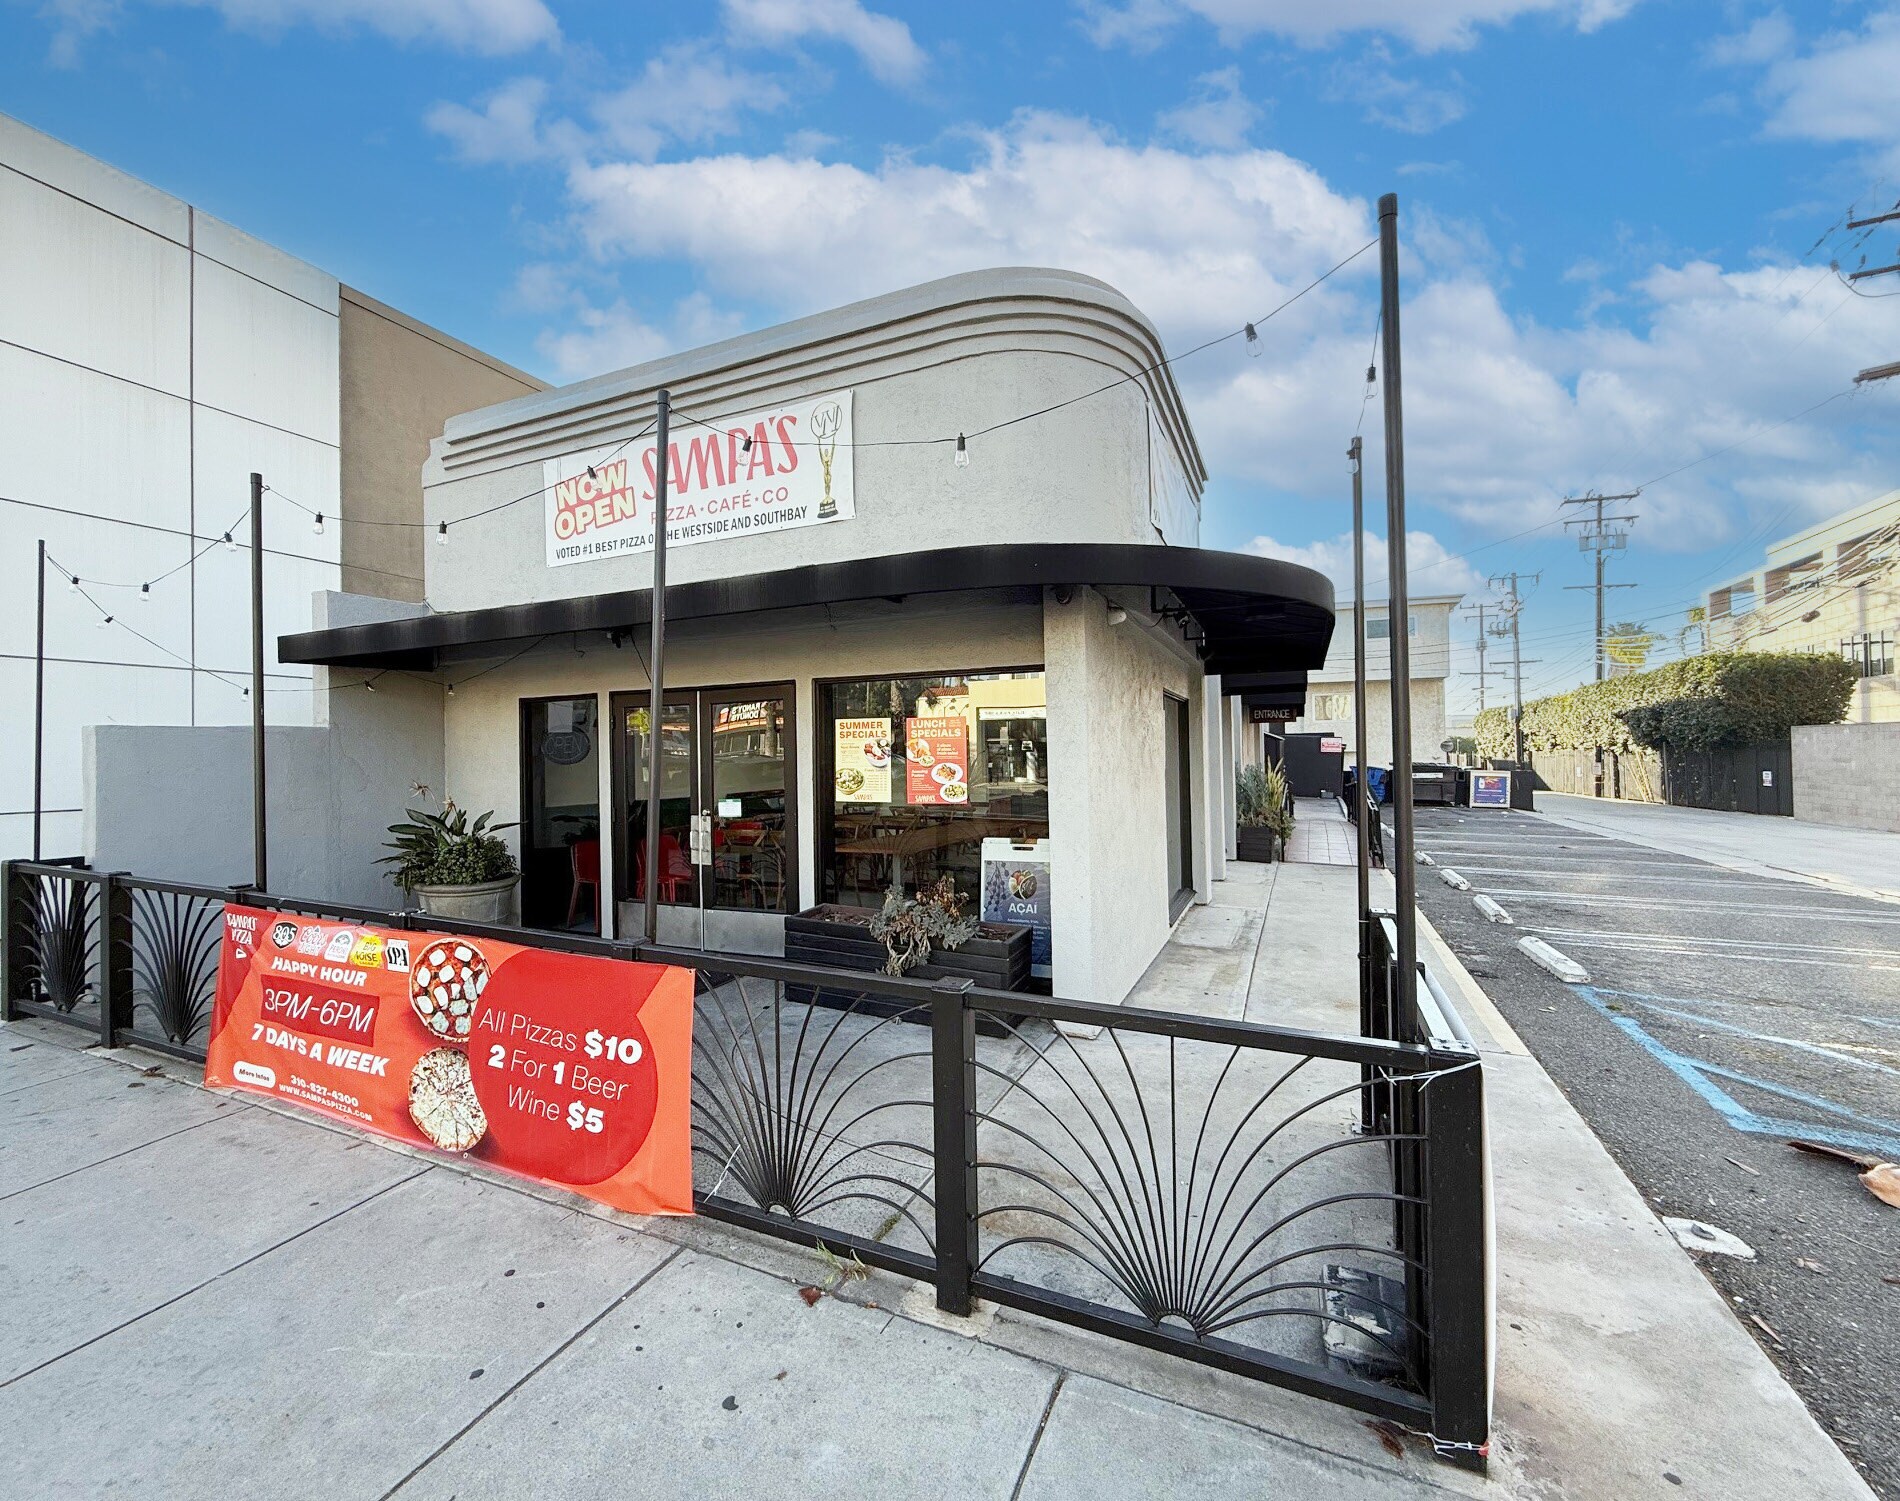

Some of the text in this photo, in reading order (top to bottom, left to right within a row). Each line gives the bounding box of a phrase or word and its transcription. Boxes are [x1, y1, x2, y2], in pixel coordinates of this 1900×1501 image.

[642, 414, 799, 501] SAMPA'S
[555, 459, 627, 511] NOW
[555, 486, 636, 540] OPEN
[651, 503, 697, 525] PZZA
[762, 486, 789, 504] CO
[556, 545, 581, 559] VOTED
[582, 543, 594, 554] #1
[595, 539, 618, 552] BEST
[620, 535, 646, 548] PIZZA
[666, 529, 680, 540] HE
[682, 519, 729, 538] WESTSIDE
[731, 515, 751, 530] AND
[753, 506, 808, 526] SOUTHBAY
[839, 721, 883, 730] SUMMER
[911, 719, 946, 729] LUNCH
[911, 728, 961, 738] SPECIALS
[1254, 708, 1290, 719] ENTRANCE
[839, 730, 887, 739] SPECIALS
[272, 925, 297, 943] 805
[271, 956, 368, 987] HAPPY HOUR
[355, 951, 378, 962] NOISE
[265, 988, 374, 1033] 3PM-6PM
[251, 1023, 390, 1077] 7 DAYS A WEEK
[478, 1007, 643, 1065] All Pizzas $10
[238, 1068, 254, 1078] More
[290, 1075, 359, 1107] 310-827-4300
[487, 1044, 629, 1100] 2 For 1 Beer
[279, 1083, 373, 1122] WWW.SAMPASPIZZA.COM
[508, 1084, 605, 1133] Wine $5
